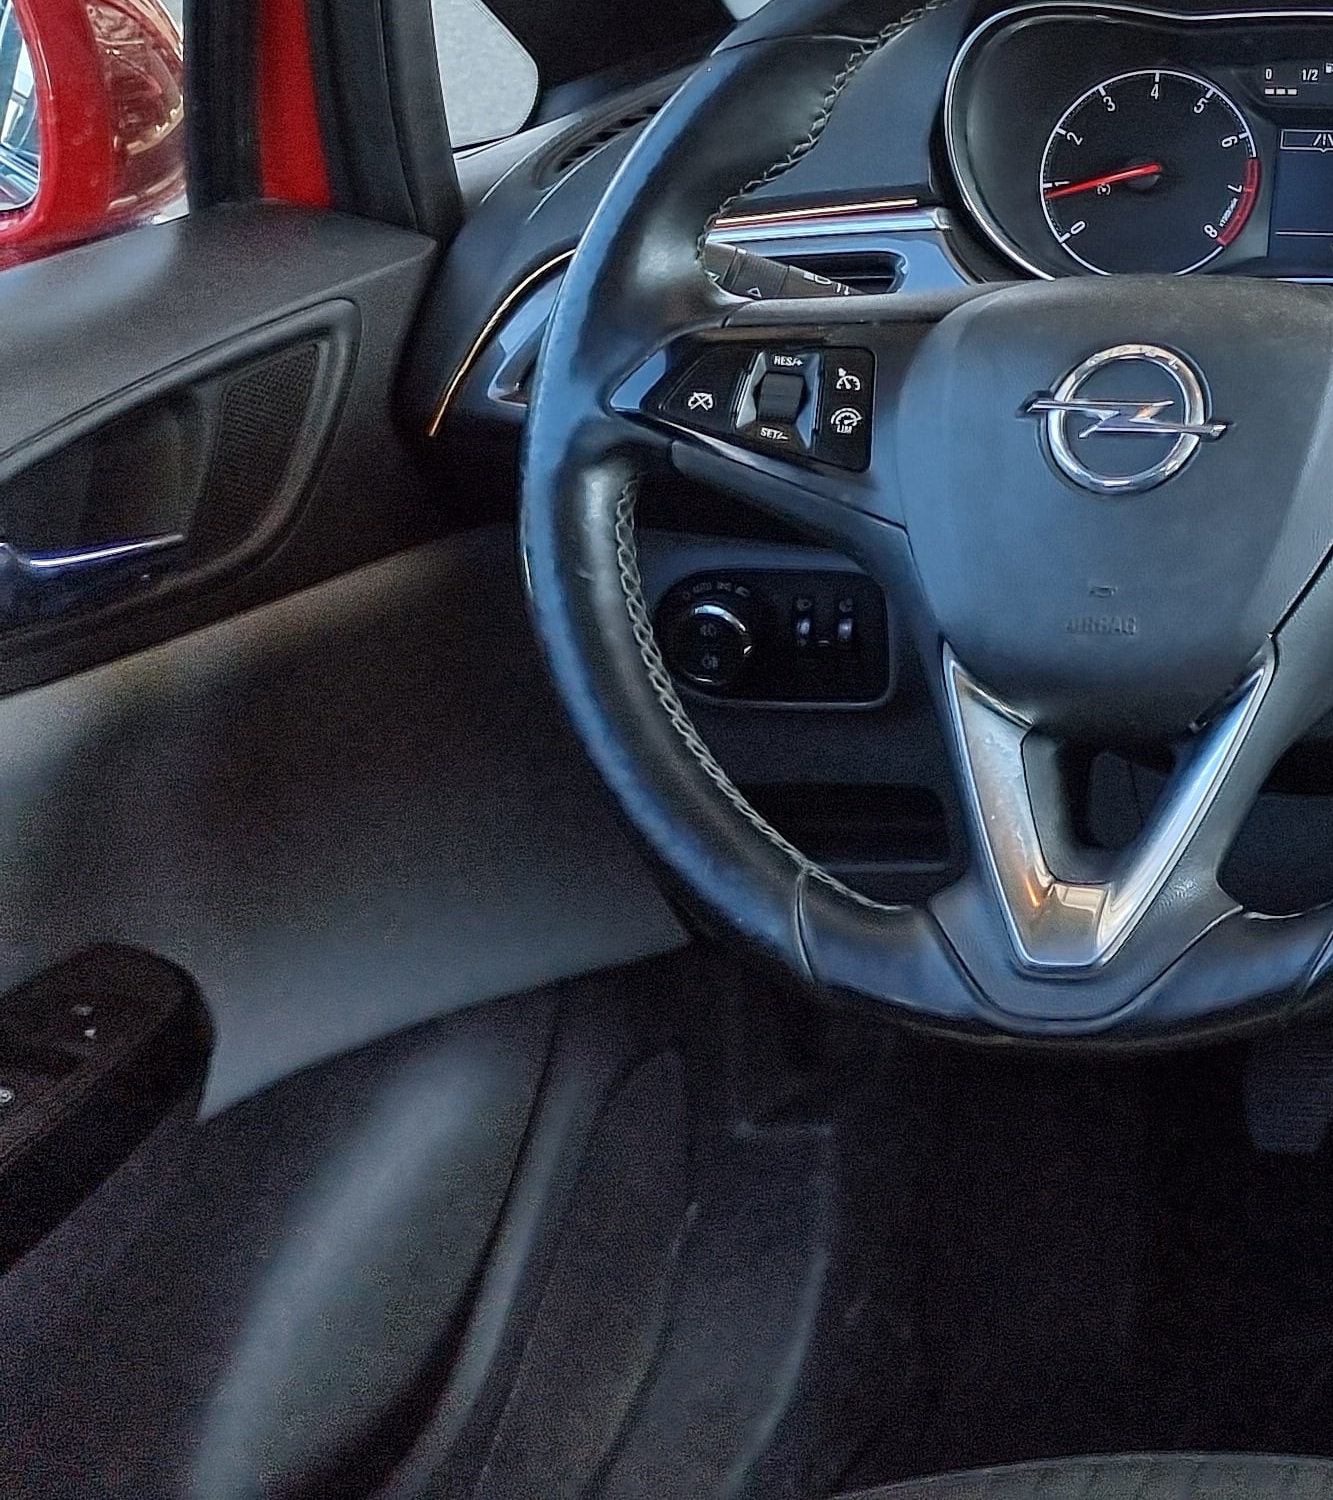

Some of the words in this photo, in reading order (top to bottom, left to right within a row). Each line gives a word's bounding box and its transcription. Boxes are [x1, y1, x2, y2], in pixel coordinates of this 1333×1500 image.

[1265, 68, 1272, 80] 0
[1301, 69, 1318, 81] 1/2
[1150, 83, 1160, 100] 4
[1102, 96, 1116, 112] 3
[1193, 97, 1208, 114] 5
[1066, 131, 1084, 146] 2
[1221, 135, 1238, 148] 6
[1227, 183, 1243, 194] 7
[1068, 219, 1087, 235] 0
[1203, 223, 1218, 238] 8
